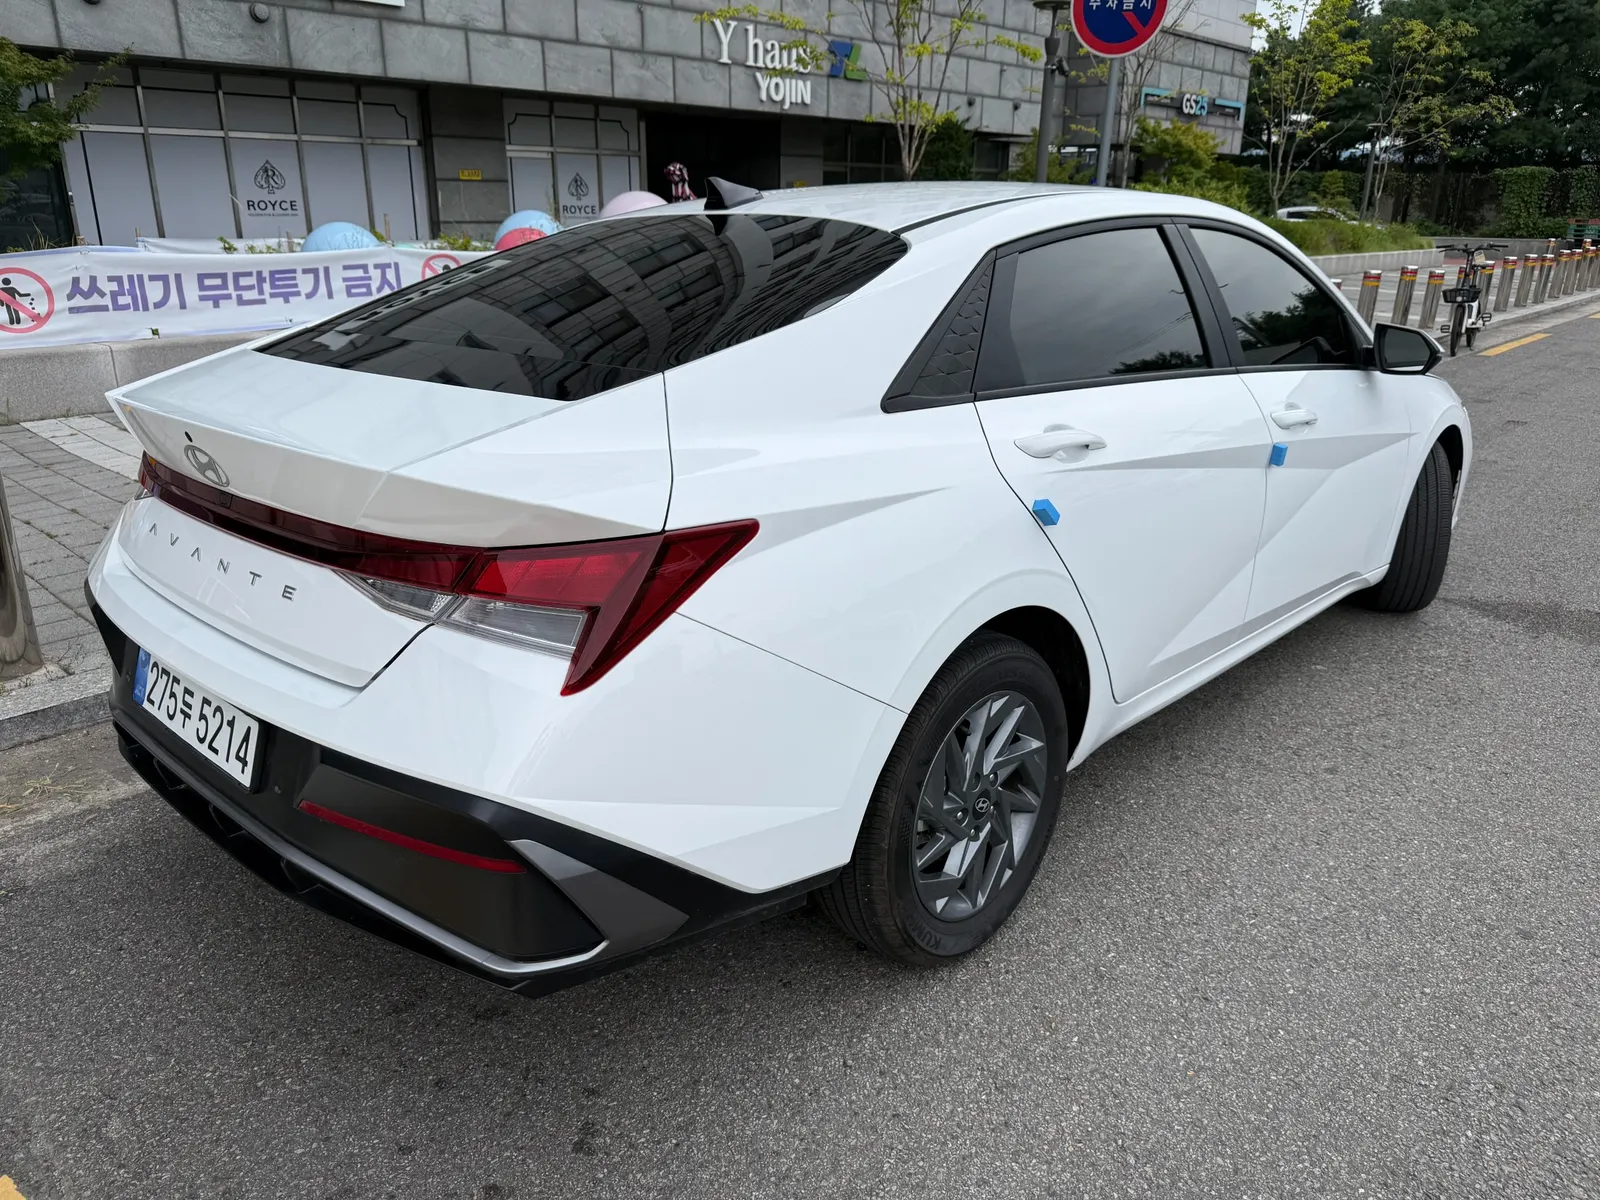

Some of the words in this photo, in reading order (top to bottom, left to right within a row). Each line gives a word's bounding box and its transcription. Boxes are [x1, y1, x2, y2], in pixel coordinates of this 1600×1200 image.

[712, 18, 738, 64] Y
[755, 72, 812, 110] YOJIN
[1182, 93, 1209, 117] GS25
[246, 199, 298, 211] ROYCE
[562, 204, 597, 215] ROYCE
[65, 272, 188, 315] 쓰레기
[196, 265, 335, 309] 무단투기
[341, 261, 402, 299] 금지
[149, 522, 298, 602] AVANTE
[146, 660, 195, 729] 275두
[196, 695, 252, 775] 5214
